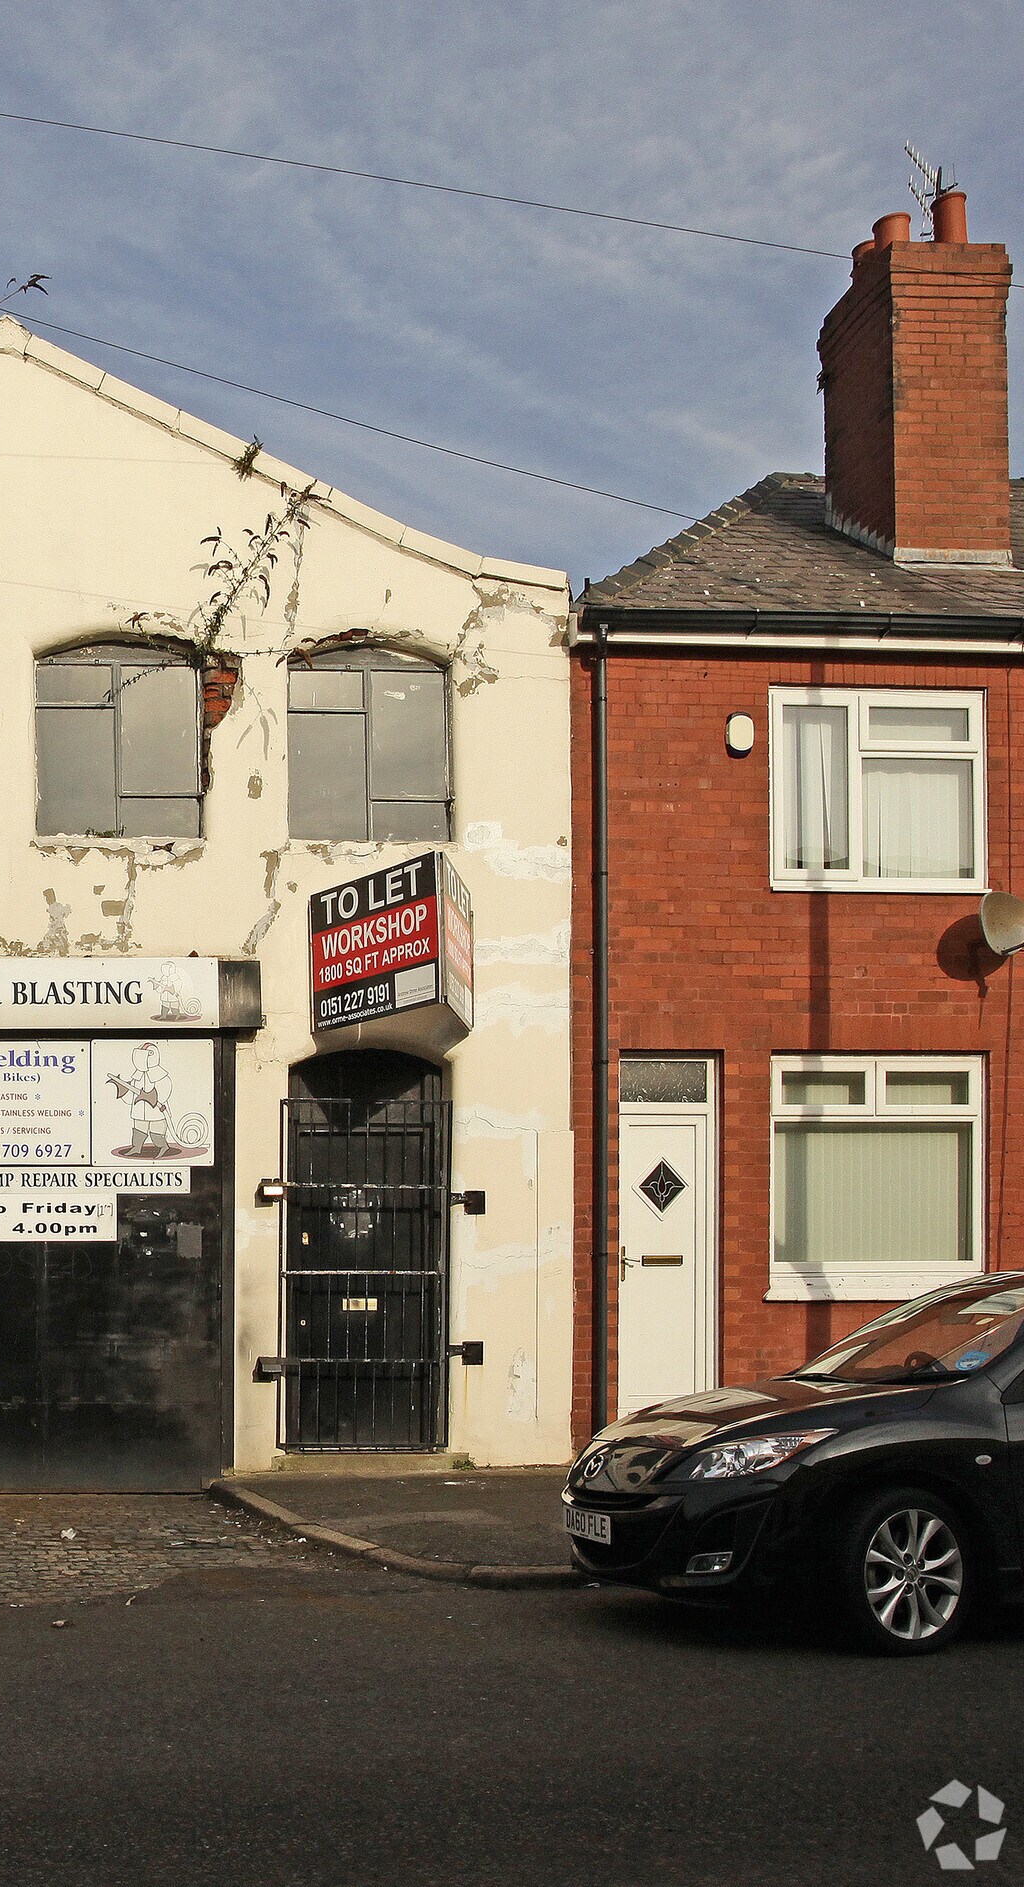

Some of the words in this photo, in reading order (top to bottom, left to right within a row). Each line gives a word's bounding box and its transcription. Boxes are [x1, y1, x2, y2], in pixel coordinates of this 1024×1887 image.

[321, 886, 359, 925] TO
[368, 861, 422, 911] LET
[322, 904, 428, 960] WORKSHOP
[318, 963, 343, 984] 1800
[345, 956, 362, 977] SQ
[364, 951, 379, 971] FT
[382, 937, 431, 967] APPROX
[12, 981, 143, 1006] BLASTING
[320, 995, 342, 1018] 0151
[344, 989, 364, 1012] 227
[367, 982, 390, 1006] 9191
[317, 1002, 394, 1028] www.orme-associates.co.uk
[3, 1072, 41, 1084] Bikes)
[37, 1109, 72, 1117] WELDING
[6, 1127, 11, 1135] /
[12, 1127, 52, 1135] SERVICING
[35, 1144, 72, 1158] 6927
[20, 1172, 78, 1188] REPAIR
[85, 1172, 183, 1188] SPECIALISTS
[22, 1203, 96, 1217] Friday
[12, 1223, 98, 1236] 4.00pm
[566, 1509, 586, 1532] DA60
[588, 1514, 607, 1538] FLE
